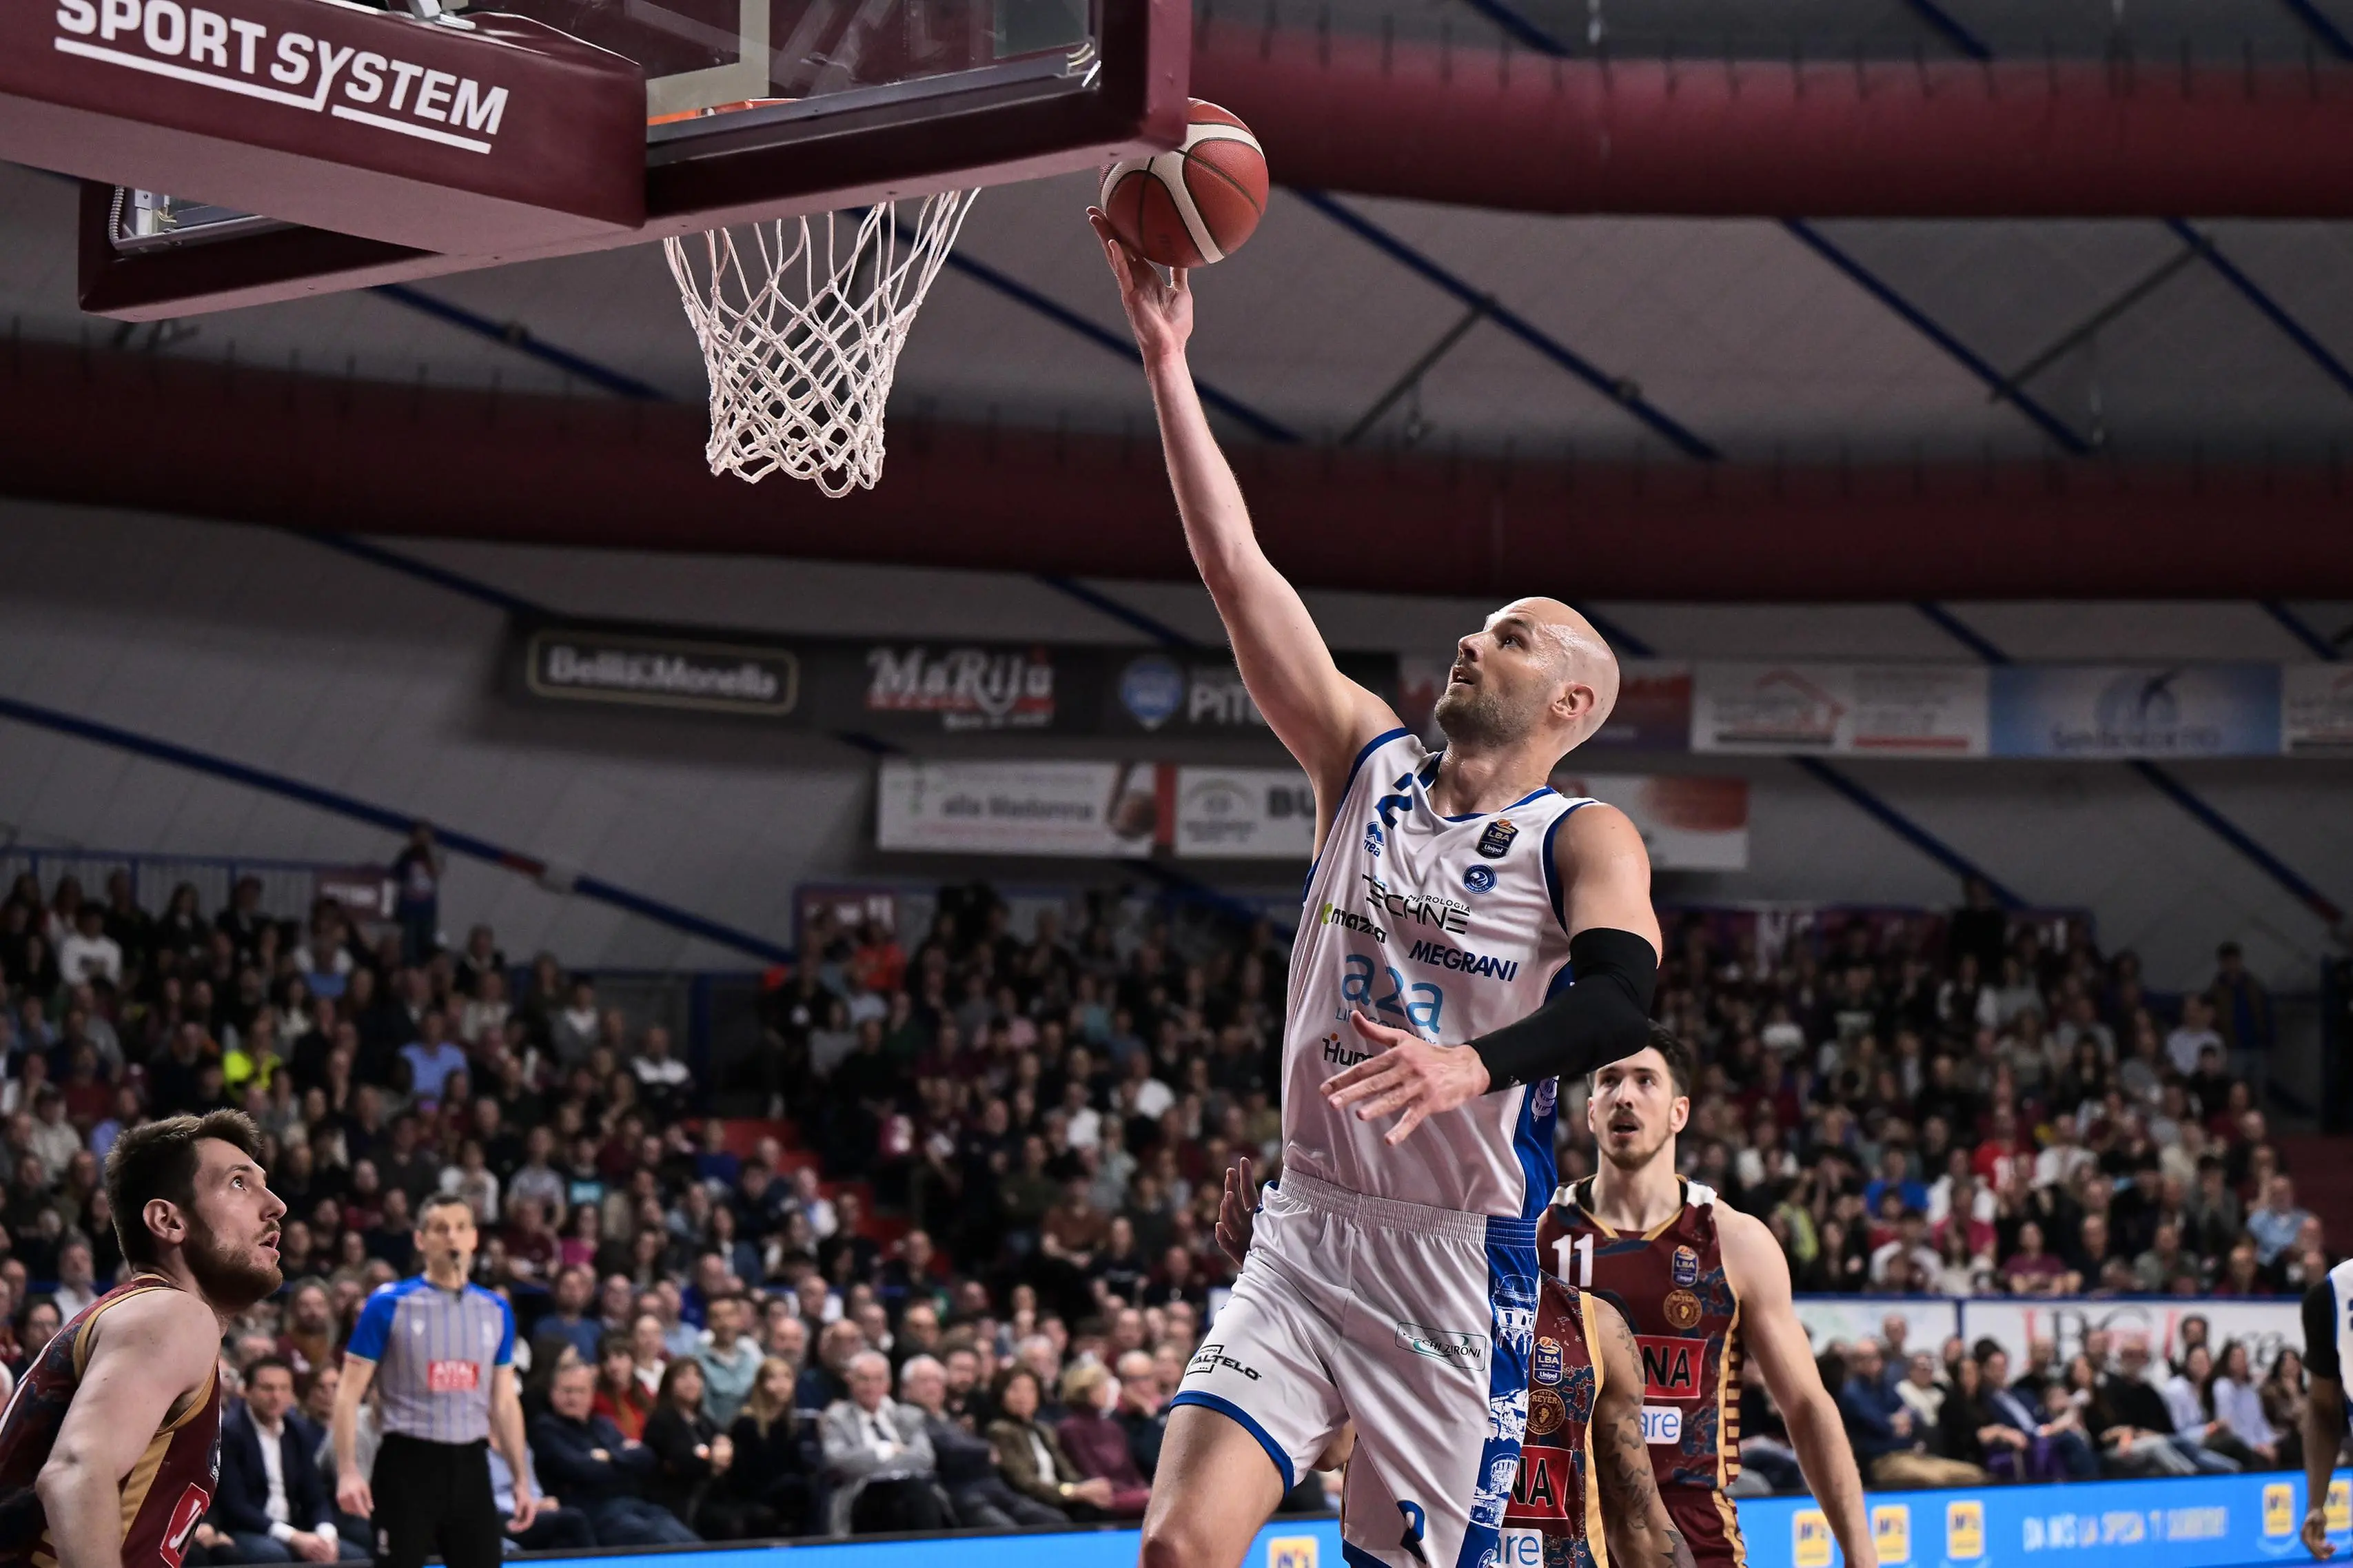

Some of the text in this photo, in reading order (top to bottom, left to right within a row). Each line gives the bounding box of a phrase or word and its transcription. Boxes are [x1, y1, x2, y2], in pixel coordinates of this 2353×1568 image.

[56, 0, 510, 135] SPORT SYSTEM
[1487, 830, 1510, 842] LBA
[1484, 844, 1504, 854] Unipol
[1408, 939, 1518, 982] MEGRANI
[1342, 954, 1443, 1034] a2a
[1551, 1234, 1594, 1287] 11
[1444, 1343, 1481, 1358] ZIRONI
[1538, 1354, 1559, 1365] LBA
[1539, 1371, 1558, 1380] Unipol
[1531, 1394, 1558, 1405] REYER
